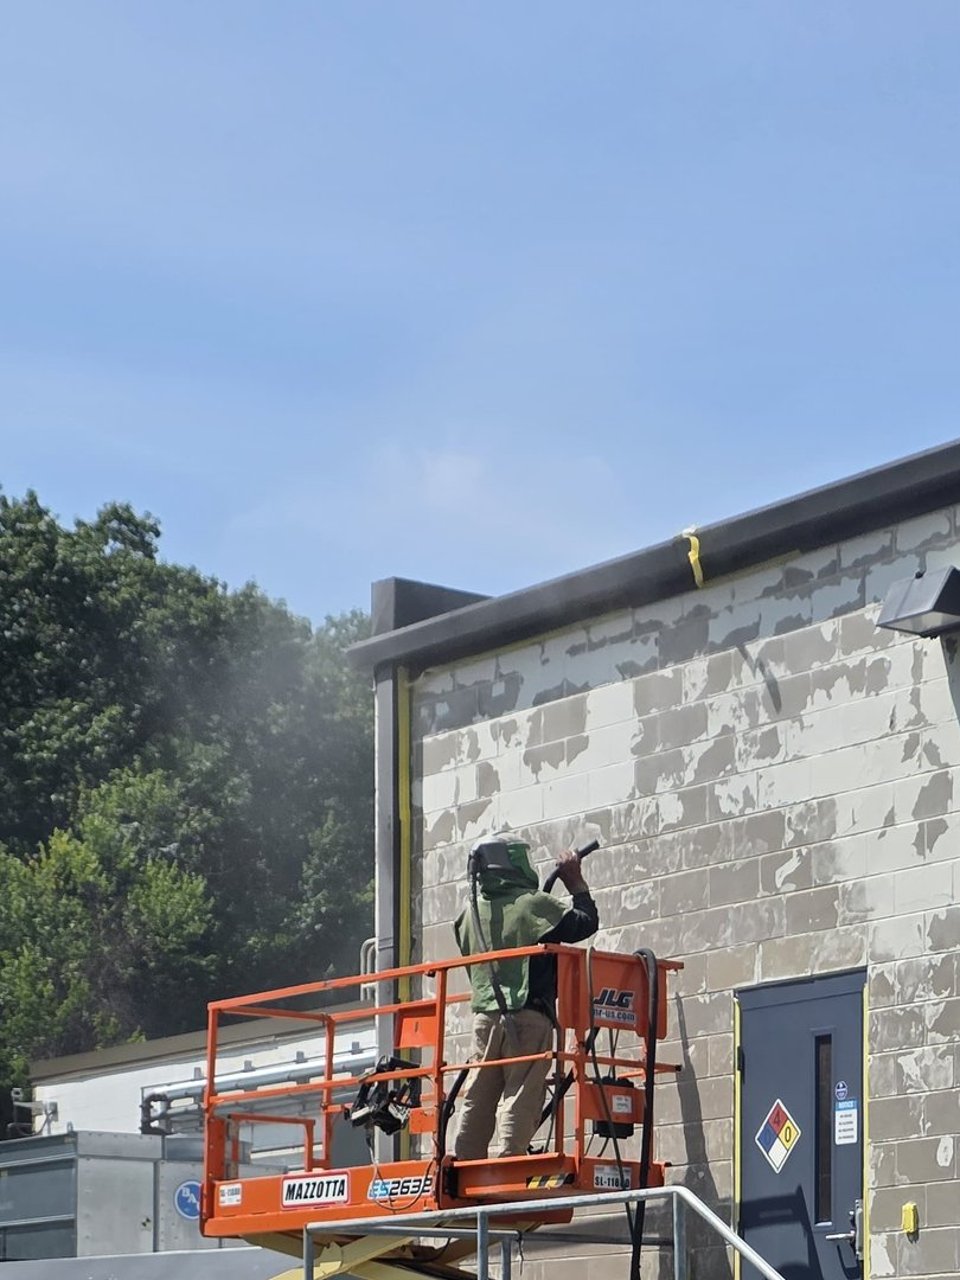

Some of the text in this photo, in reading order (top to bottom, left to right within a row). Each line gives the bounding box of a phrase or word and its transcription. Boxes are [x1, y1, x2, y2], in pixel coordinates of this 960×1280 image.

[593, 989, 634, 1008] JLG
[785, 1126, 791, 1143] 0
[182, 1187, 200, 1211] BA
[285, 1179, 345, 1201] MAZZOTTA
